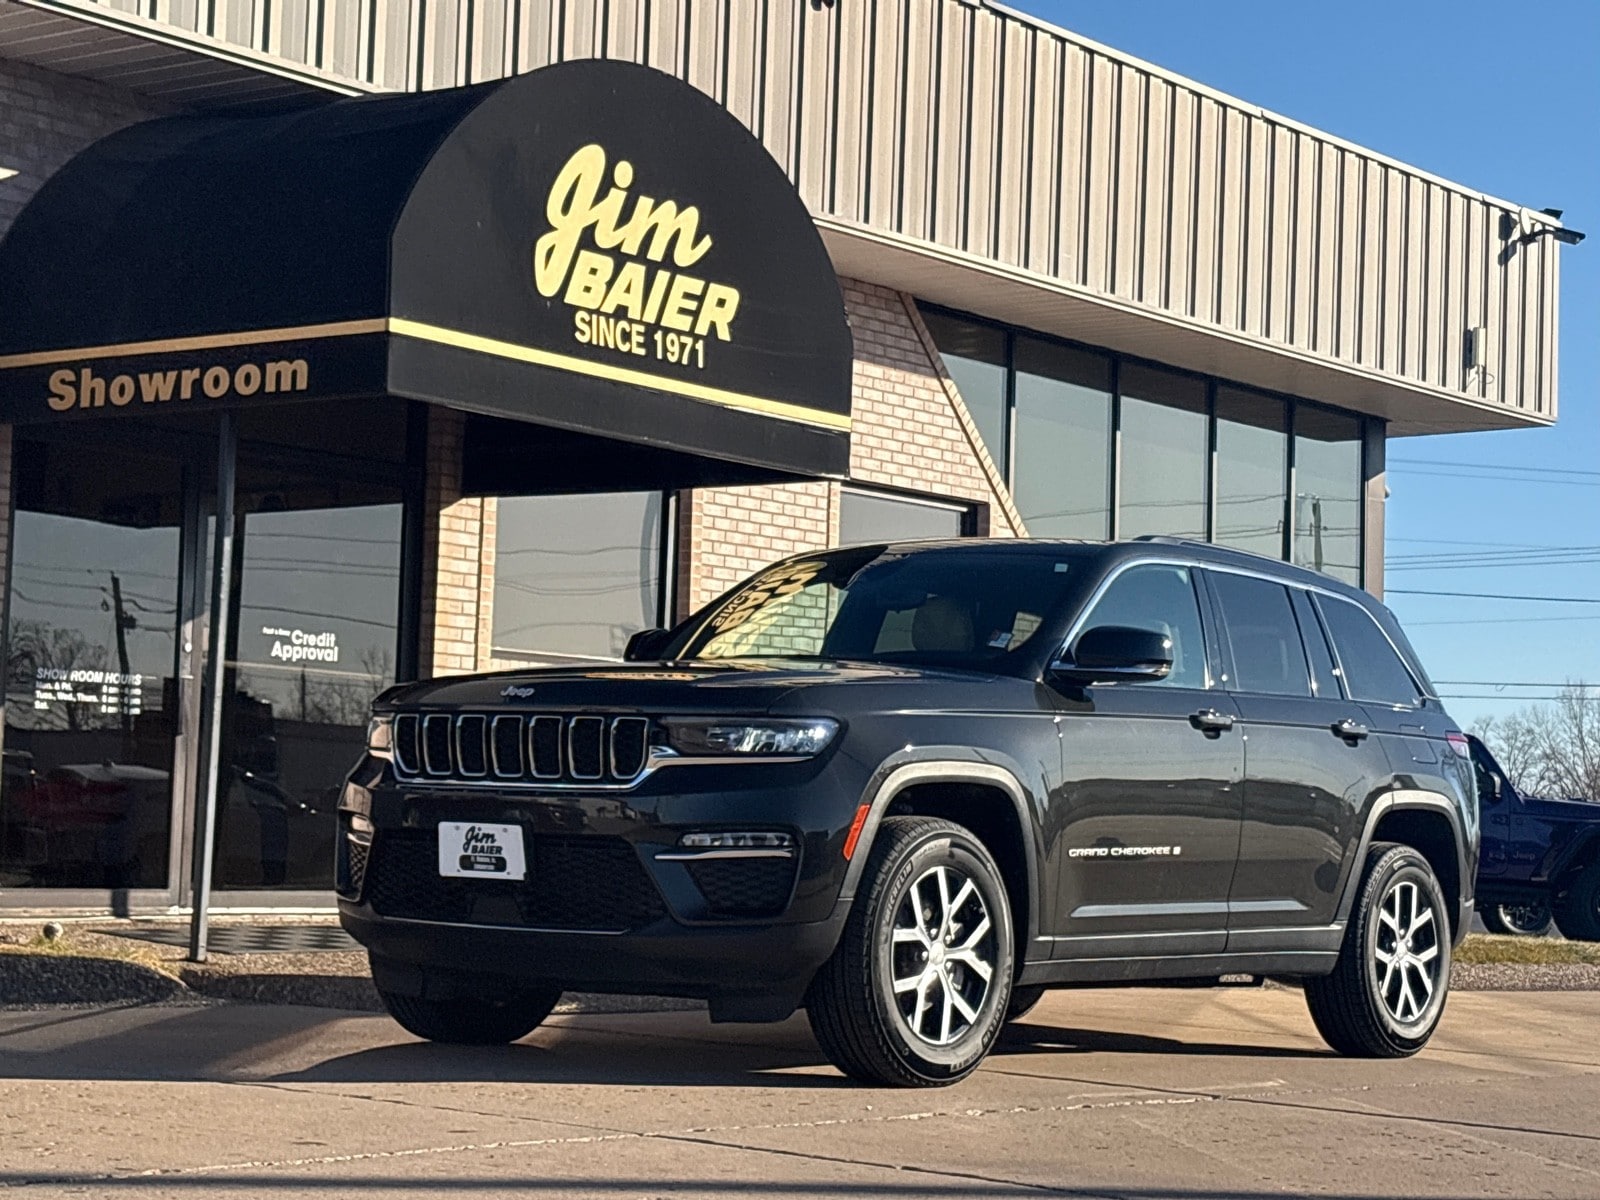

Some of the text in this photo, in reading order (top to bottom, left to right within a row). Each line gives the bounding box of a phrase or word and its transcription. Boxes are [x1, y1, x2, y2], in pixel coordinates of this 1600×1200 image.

[534, 143, 713, 297] Jim
[563, 249, 740, 342] BAIER
[574, 310, 704, 369] SINCE 1971
[47, 358, 309, 411] Showroom
[292, 629, 335, 647] Credit
[270, 640, 339, 662] Approval
[36, 667, 142, 685] SHOW ROOM HOURS
[500, 685, 535, 698] Jeep
[463, 825, 497, 853] Jim
[471, 844, 503, 855] BAIER
[1068, 846, 1171, 857] GRAND CHEROKEE
